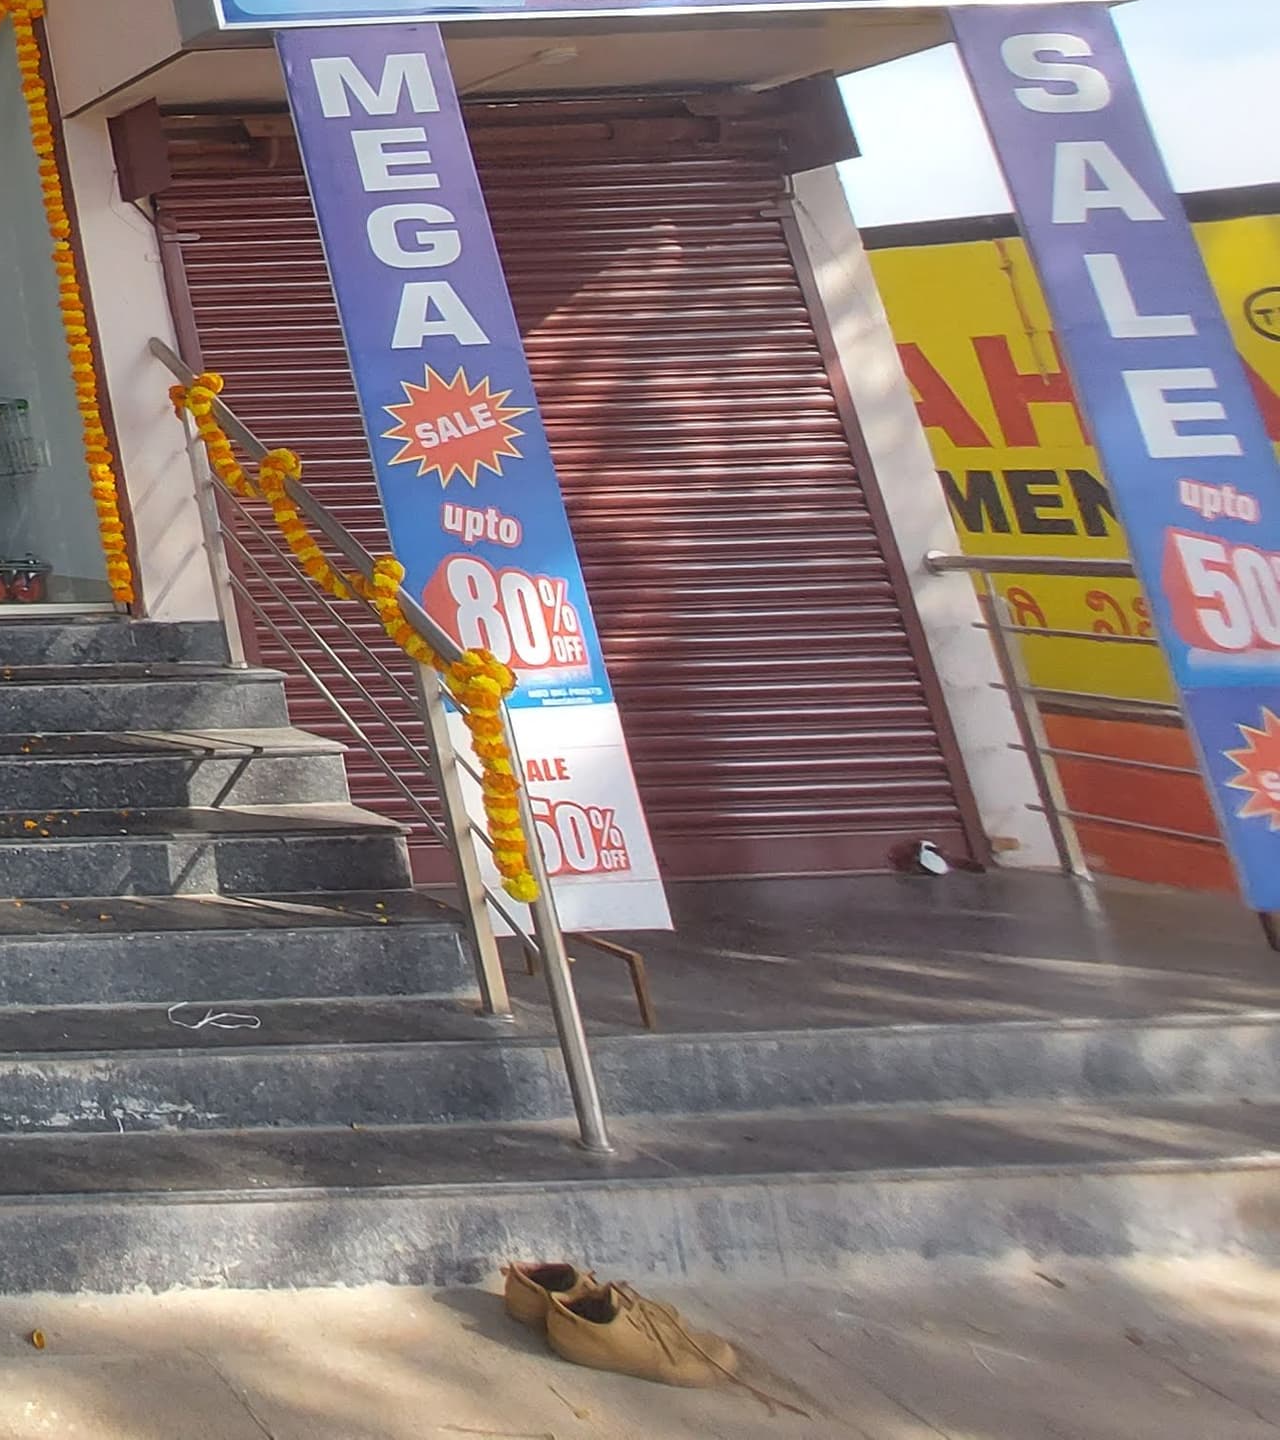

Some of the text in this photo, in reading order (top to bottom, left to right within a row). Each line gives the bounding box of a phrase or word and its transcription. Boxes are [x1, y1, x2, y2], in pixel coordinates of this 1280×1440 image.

[310, 53, 492, 351] MEGA
[999, 32, 1243, 460] SALE
[415, 403, 497, 450] SALE
[1179, 479, 1259, 524] upto
[442, 503, 520, 547] upto
[445, 556, 579, 668] 80%
[1174, 532, 1280, 650] 50
[552, 635, 584, 664] OFF
[525, 757, 572, 782] ALE
[600, 850, 628, 870] OFF
